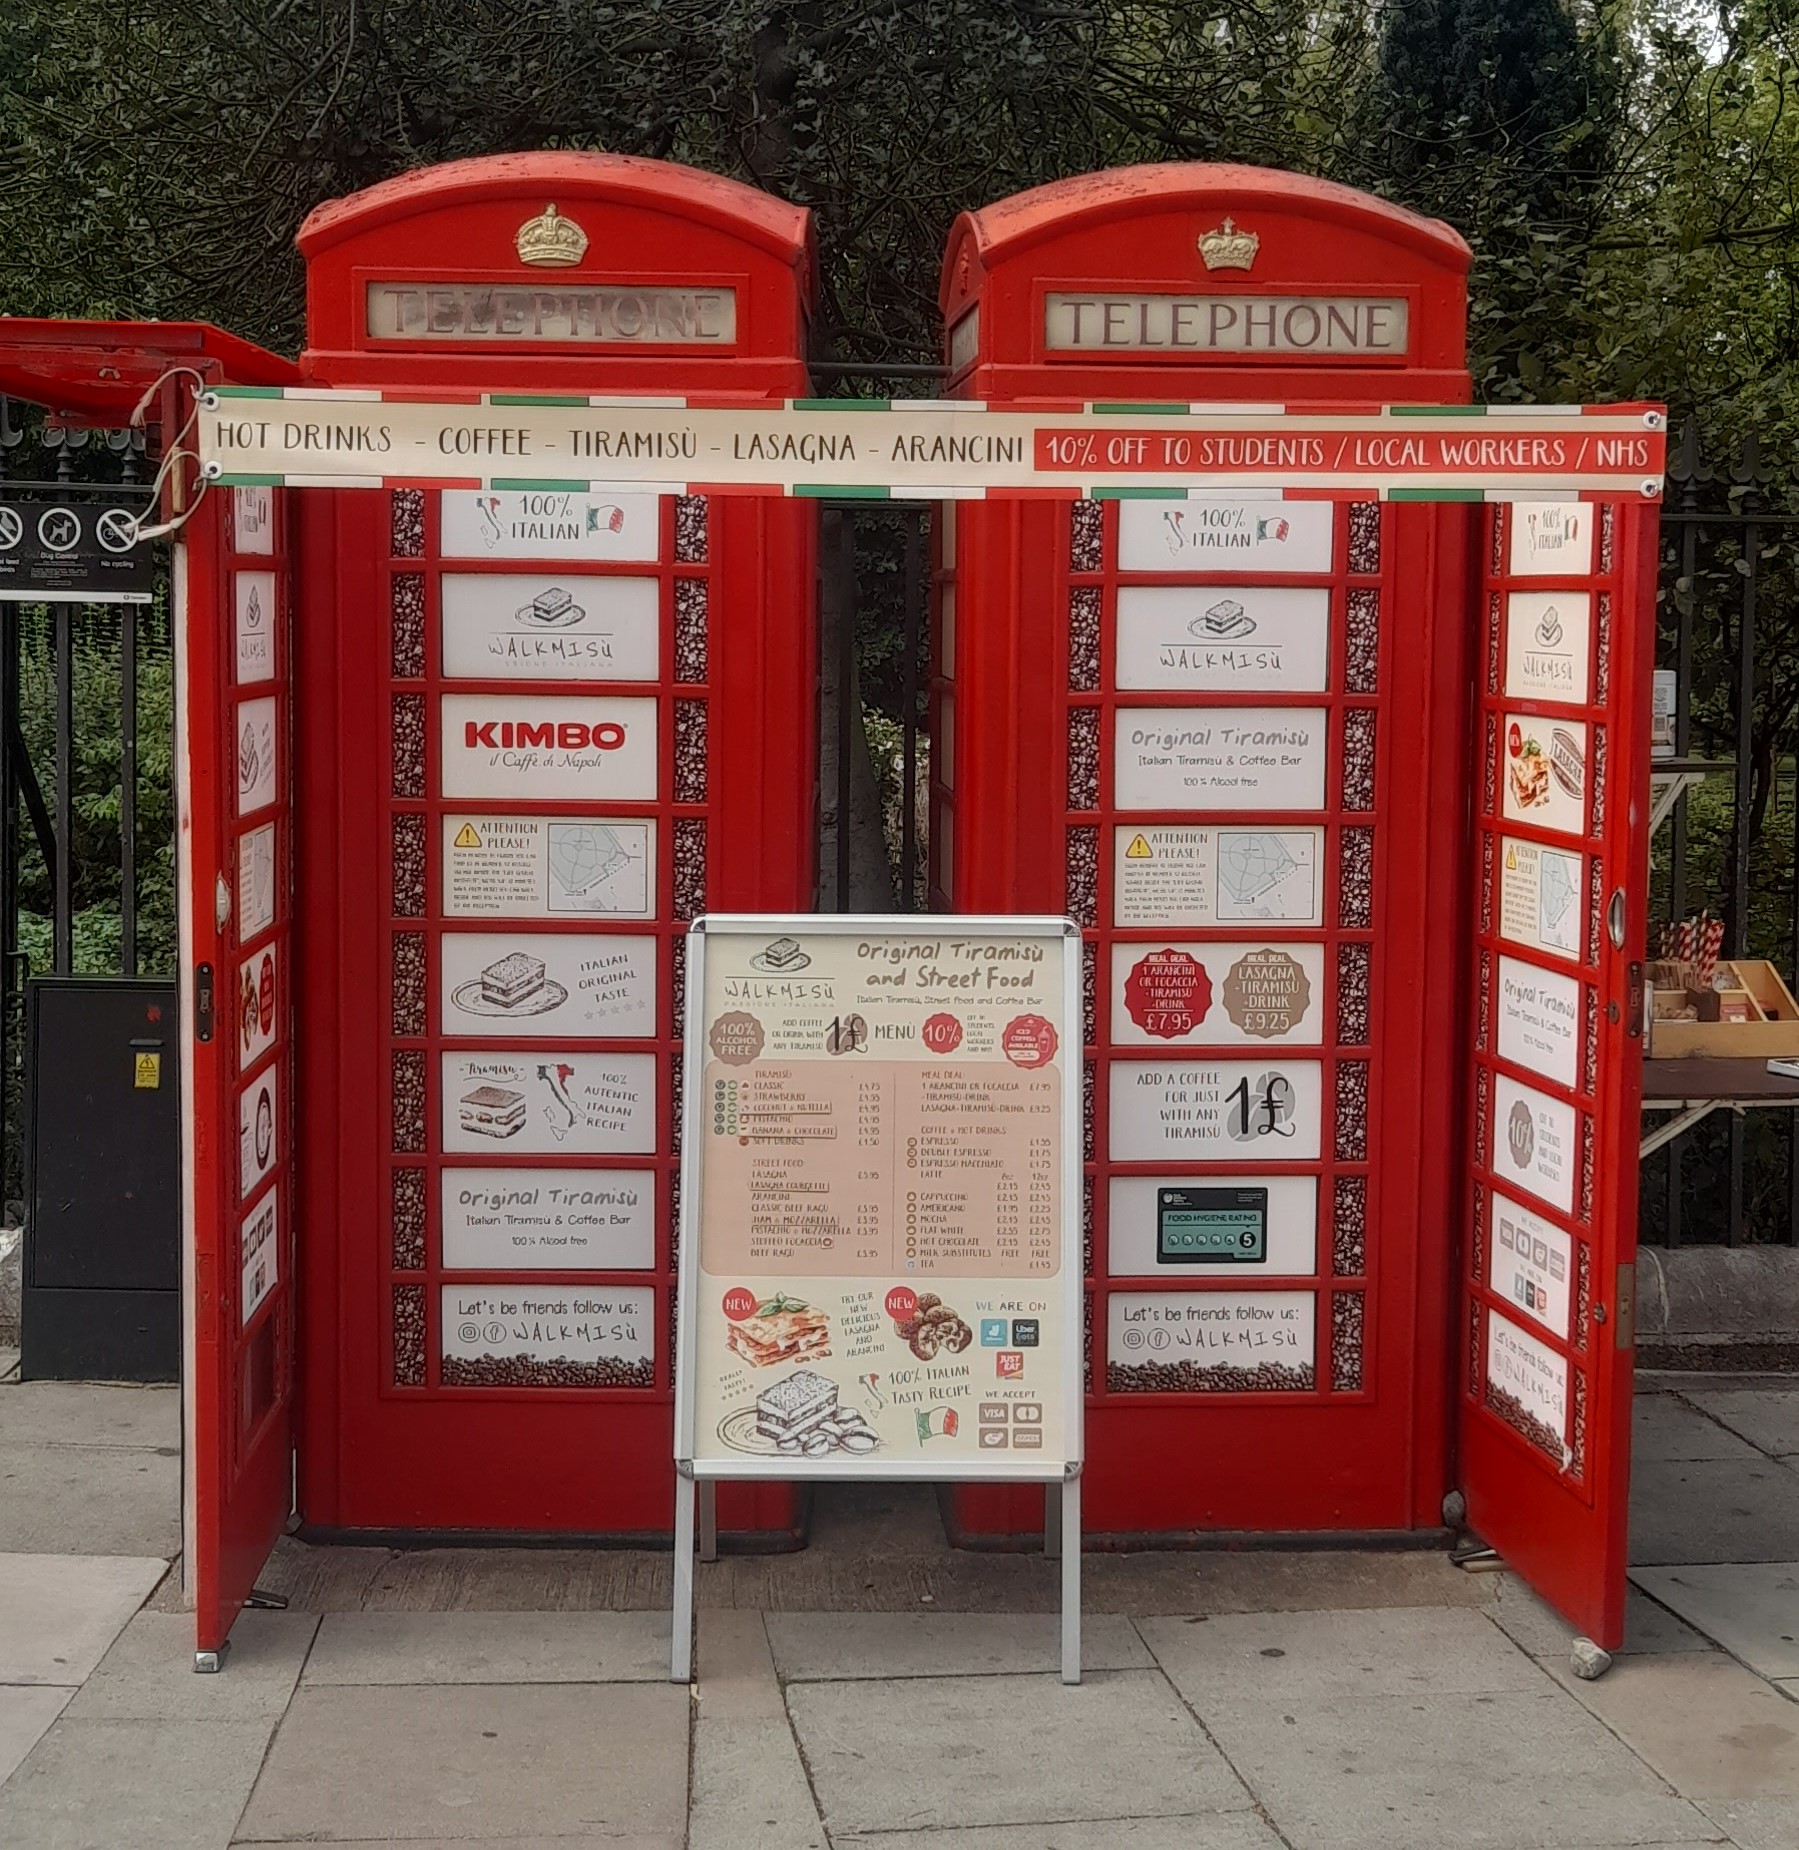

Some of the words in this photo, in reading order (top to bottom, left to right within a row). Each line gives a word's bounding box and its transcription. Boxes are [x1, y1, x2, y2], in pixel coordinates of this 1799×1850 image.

[383, 289, 721, 339] TELEPHONE
[1061, 301, 1393, 348] TELEPHONE
[217, 421, 270, 450] HOT
[283, 422, 392, 452] DRINKS
[438, 426, 532, 456] COFFEE
[568, 425, 697, 459] TIRAMISÙ
[733, 433, 856, 465] LASAGNA
[891, 434, 1022, 464] ARANCINI
[1045, 436, 1098, 466] 10%
[1107, 437, 1150, 466] OFF
[1160, 437, 1192, 465] TO
[1199, 436, 1324, 466] STUDENTS
[1355, 438, 1430, 467] LOCAL
[1440, 438, 1565, 468] WORKERS
[1597, 439, 1648, 468] NHS
[520, 494, 573, 517] 100%
[1200, 508, 1246, 528] 100%
[1542, 508, 1561, 529] 100%
[512, 523, 579, 540] ITALIAN
[1193, 533, 1251, 547] ITALIAN
[465, 721, 627, 750] KIMBO
[1131, 728, 1211, 750] Original
[1220, 728, 1309, 747] Tiramisù
[557, 752, 602, 772] Napoli
[1138, 755, 1173, 766] Italian
[1176, 755, 1222, 766] Tiramisù
[1226, 755, 1234, 766] &
[1239, 755, 1276, 766] Coffee
[1281, 755, 1302, 766] Bar
[480, 822, 538, 834] ATTENTION
[488, 837, 530, 849] PLEASE!
[1151, 832, 1208, 844] ATTENTION
[1158, 847, 1200, 859] PLEASE!
[857, 941, 940, 964] Original
[950, 942, 1043, 962] Tiramisù
[1149, 955, 1168, 963] MEAL
[1170, 955, 1189, 963] DEAL
[1247, 955, 1266, 963] MEAL
[1268, 955, 1287, 963] DEAL
[580, 954, 628, 972] ITALIAN
[866, 967, 906, 987] and
[916, 965, 981, 988] Street
[986, 966, 1034, 989] Food
[1150, 965, 1196, 976] ARANCINI
[1238, 966, 1296, 981] LASAGNA
[578, 970, 637, 989] ORIGINAL
[1139, 977, 1153, 987] OR
[1155, 977, 1198, 987] FOCACCIA
[595, 988, 629, 1003] TASTE
[1504, 977, 1537, 1003] Original
[1026, 996, 1043, 1004] Bar
[719, 1022, 755, 1036] 100%
[1145, 1013, 1192, 1031] £7.95
[1243, 1013, 1290, 1031] £9.25
[874, 1021, 916, 1040] MENÙ
[924, 1022, 960, 1045] 10%
[715, 1036, 758, 1045] ALCOHOL
[721, 1045, 752, 1056] FREE
[601, 1073, 627, 1085] 100%
[1137, 1072, 1163, 1086] ADD
[1167, 1073, 1175, 1085] A
[1180, 1072, 1220, 1085] COFFEE
[584, 1085, 639, 1102] AUTENTIC
[1165, 1091, 1187, 1103] FOR
[1192, 1090, 1219, 1103] JUST
[587, 1101, 631, 1117] ITALIAN
[1160, 1108, 1191, 1121] WITH
[1196, 1108, 1220, 1121] ANY
[586, 1117, 627, 1131] RECIPE
[975, 1125, 1007, 1135] DRINKS
[1509, 1115, 1532, 1155] 10%
[459, 1188, 539, 1211] Original
[549, 1188, 638, 1207] Tiramisù
[466, 1214, 500, 1226] Italian
[504, 1214, 550, 1226] Tiramisù
[554, 1214, 563, 1226] &
[567, 1214, 605, 1226] Coffee
[609, 1214, 631, 1225] Bar
[1168, 1214, 1192, 1222] FOOD
[1193, 1214, 1227, 1222] HYGIENE
[1229, 1214, 1257, 1222] RATING
[1243, 1234, 1253, 1246] 5
[458, 1300, 494, 1315] Let's
[500, 1300, 517, 1315] be
[522, 1300, 568, 1315] friends
[573, 1299, 613, 1315] follow
[618, 1303, 639, 1315] us:
[726, 1297, 752, 1310] NEW
[888, 1296, 915, 1310] NEW
[976, 1301, 994, 1311] WE
[999, 1301, 1024, 1311] ARE
[1028, 1301, 1047, 1311] ON
[1124, 1306, 1159, 1322] Let's
[1165, 1306, 1182, 1322] be
[1186, 1306, 1231, 1322] friends
[1236, 1306, 1274, 1321] follow
[1280, 1309, 1300, 1321] us:
[1015, 1324, 1036, 1333] Uber
[1016, 1333, 1036, 1342] Eats
[999, 1355, 1021, 1364] JUST
[1003, 1362, 1020, 1371] EAT
[888, 1367, 922, 1385] 100%
[1003, 1391, 1036, 1399] ACCEPT
[984, 1408, 1006, 1419] VISA
